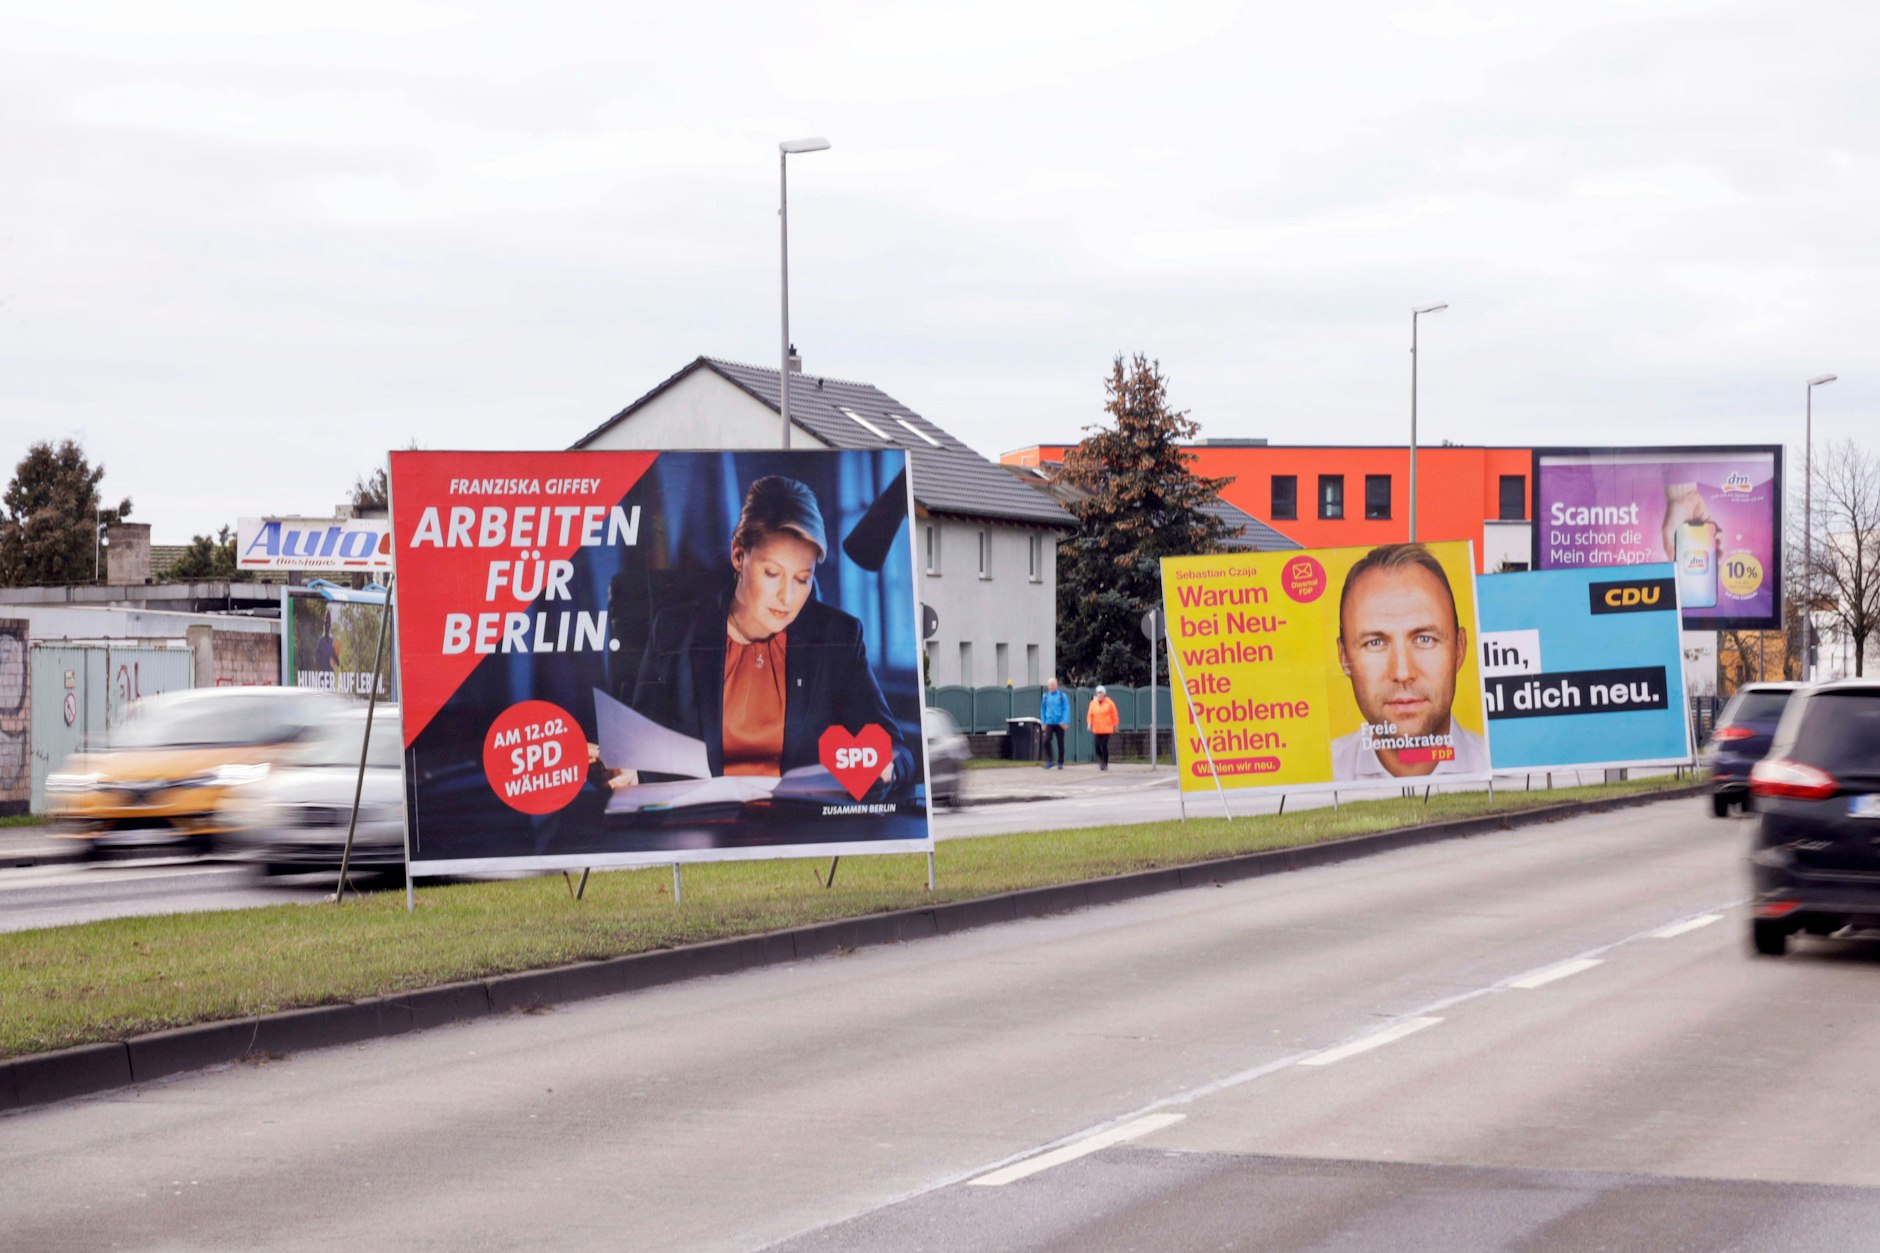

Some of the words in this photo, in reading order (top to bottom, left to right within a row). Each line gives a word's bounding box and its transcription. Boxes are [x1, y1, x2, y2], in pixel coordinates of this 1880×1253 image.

[450, 479, 540, 494] FRANZISKA
[545, 478, 601, 494] GIFFEY
[1550, 502, 1639, 526] Scannst
[409, 506, 641, 548] ARBEITEN
[1550, 530, 1571, 545] Du
[1574, 529, 1616, 545] schon
[1620, 529, 1642, 545] die
[1550, 548, 1585, 563] Mein
[1589, 548, 1652, 565] dm-App?
[485, 550, 575, 602] FÜR
[1176, 569, 1226, 580] Sebastian
[1228, 567, 1257, 578] Czaja
[1726, 561, 1745, 579] 10
[1177, 585, 1268, 608] Warum
[1604, 586, 1660, 607] CDU
[442, 611, 621, 655] BERLIN.
[1180, 613, 1219, 637] bei
[1226, 611, 1287, 634] Neu-
[1183, 641, 1273, 666] wahlen
[298, 670, 336, 693] HUNGER
[337, 671, 356, 694] AUF
[1187, 672, 1231, 696] alte
[1513, 679, 1581, 710] dich
[1590, 682, 1660, 706] neu.
[1188, 699, 1309, 725] Probleme
[493, 728, 521, 750] AM
[524, 718, 568, 741] 12.02.
[1360, 720, 1398, 736] Freie
[1189, 728, 1287, 754] wählen.
[1361, 733, 1454, 751] Demokraten
[511, 740, 562, 775] SPD
[835, 747, 879, 770] SPD
[1237, 761, 1252, 772] wir
[1431, 748, 1453, 761] FDP
[505, 765, 578, 798] WÄHLEN!
[822, 804, 868, 816] ZUSAMMEN
[868, 803, 896, 814] BERLIN
